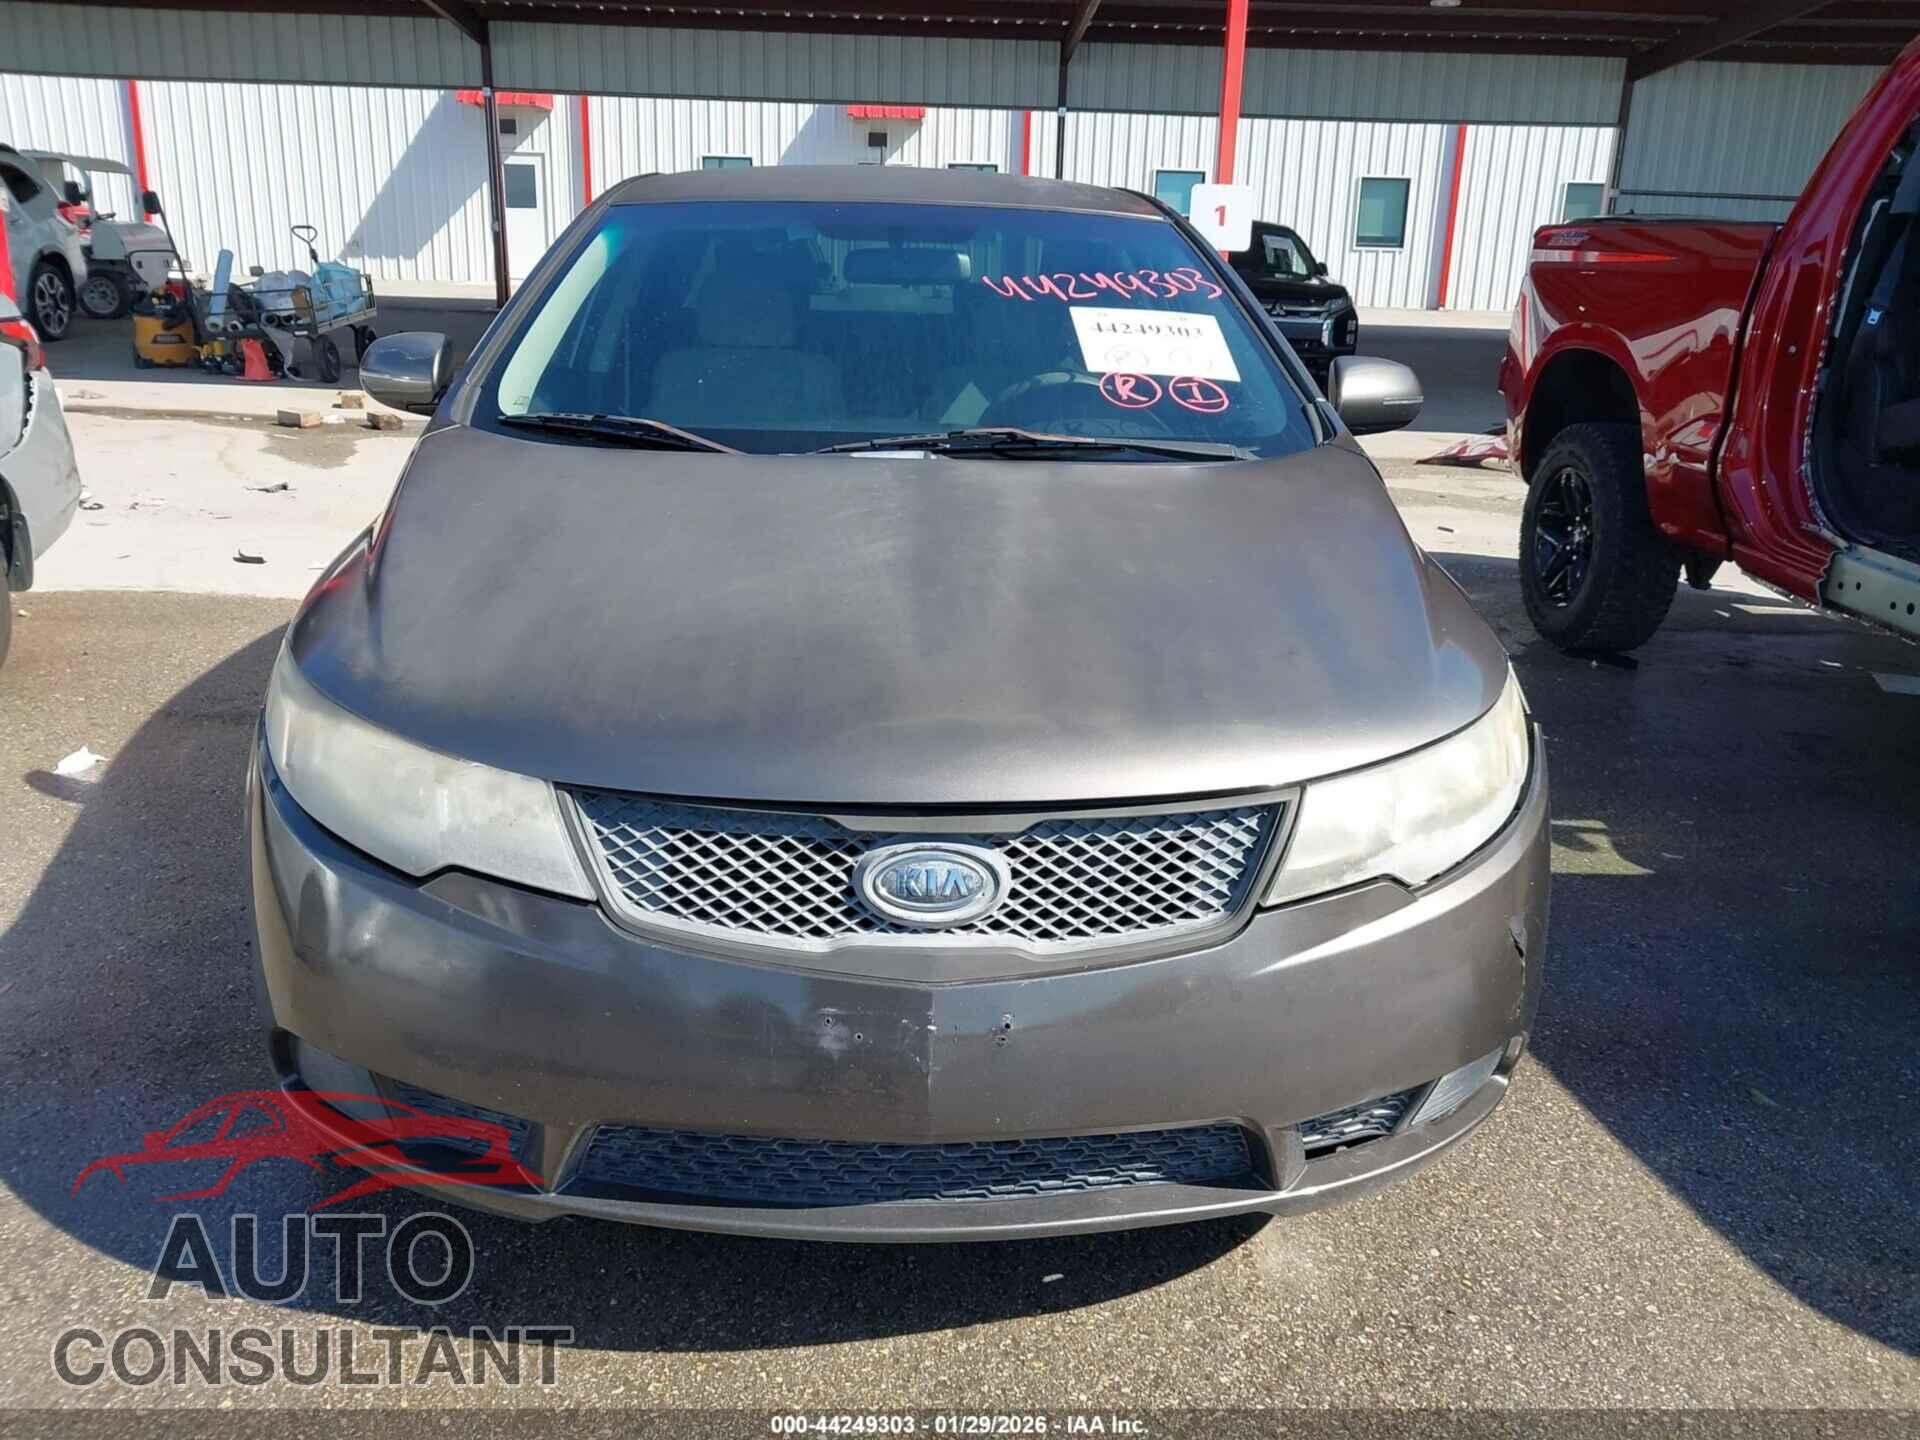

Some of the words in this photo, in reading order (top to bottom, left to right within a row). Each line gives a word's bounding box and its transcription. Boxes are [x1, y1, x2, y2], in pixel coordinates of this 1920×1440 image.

[1215, 205, 1226, 226] 1
[982, 267, 1223, 301] 44249303
[895, 867, 969, 898] KIA
